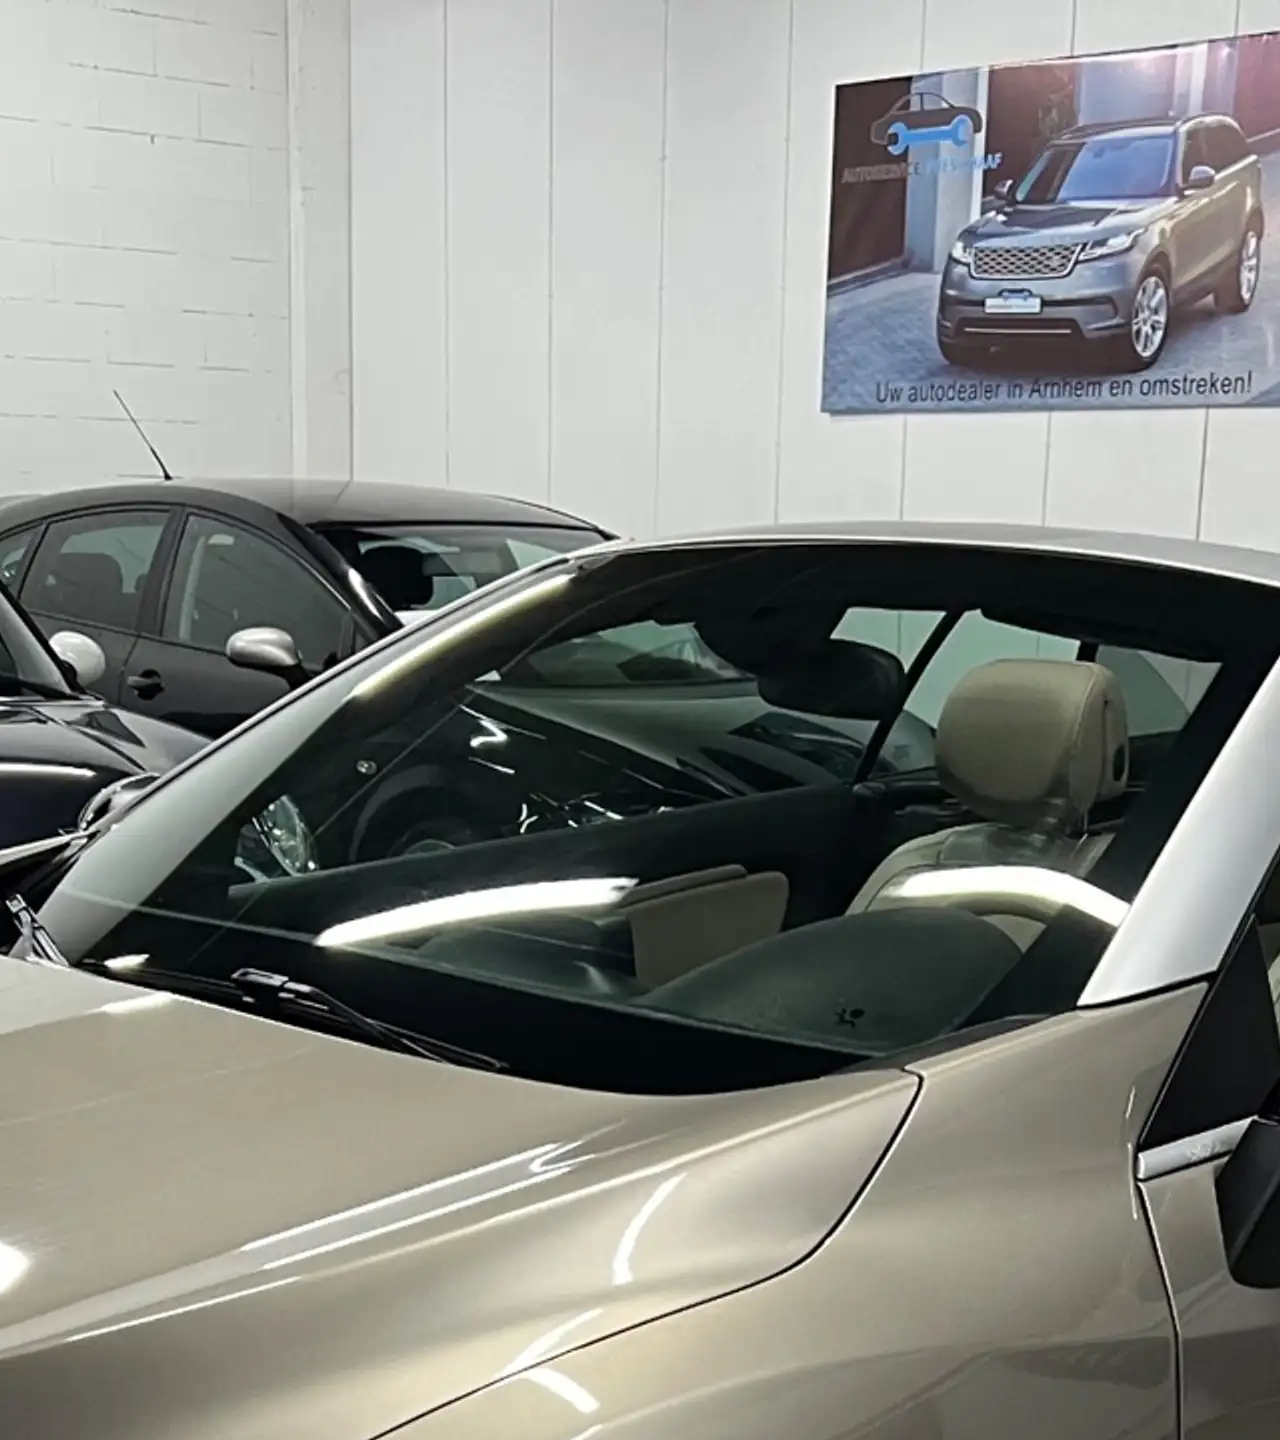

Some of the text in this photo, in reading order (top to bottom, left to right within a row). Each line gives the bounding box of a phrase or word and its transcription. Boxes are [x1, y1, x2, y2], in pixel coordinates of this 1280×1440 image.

[875, 369, 1253, 404] Uw autodealer in Arnhem en omstreken!
